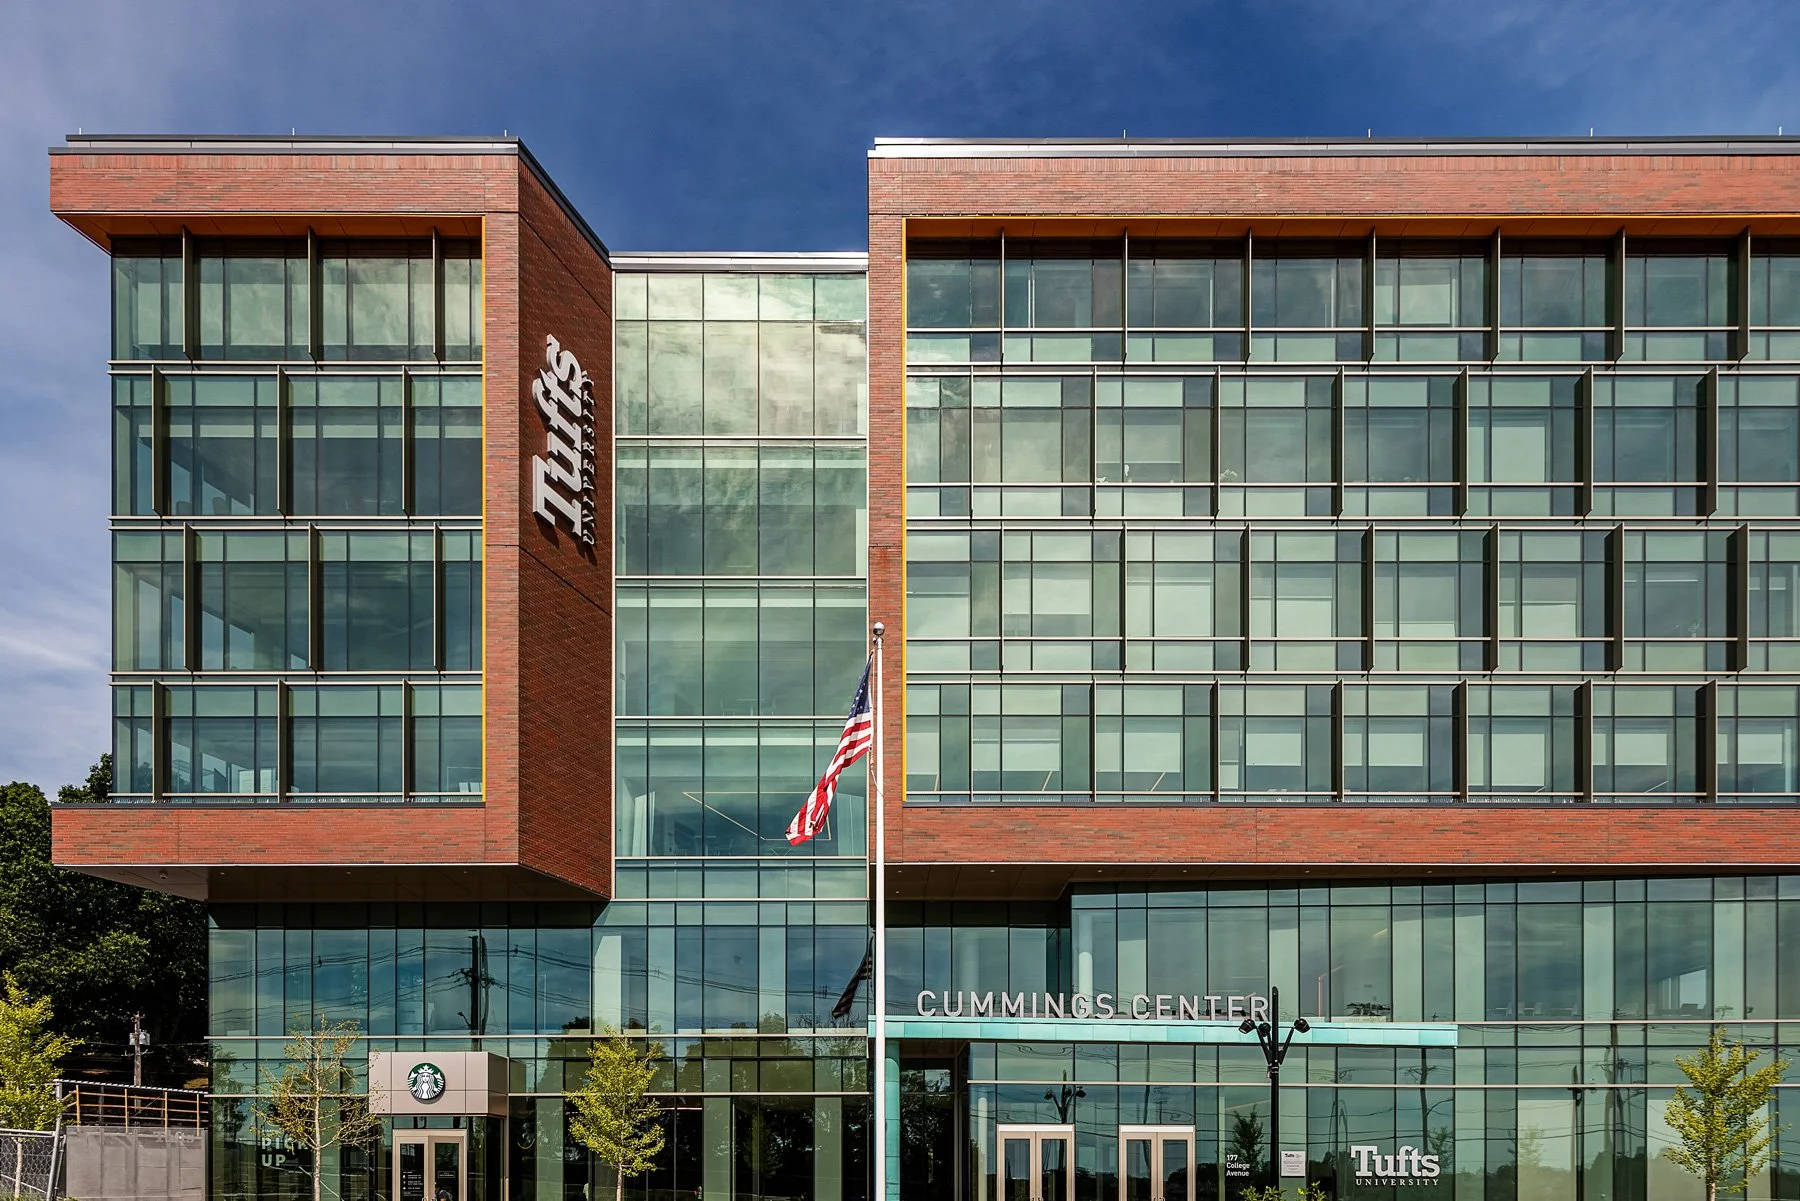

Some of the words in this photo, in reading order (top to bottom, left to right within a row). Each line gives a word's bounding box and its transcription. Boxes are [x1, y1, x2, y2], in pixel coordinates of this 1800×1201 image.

[532, 333, 583, 538] Tufts
[581, 370, 595, 545] UNIVERSITY
[917, 990, 1114, 1019] CUMMINGS
[1132, 994, 1270, 1021] CENTER
[261, 1154, 286, 1167] UP
[1226, 1162, 1251, 1170] College
[1350, 1145, 1440, 1177] Tufts
